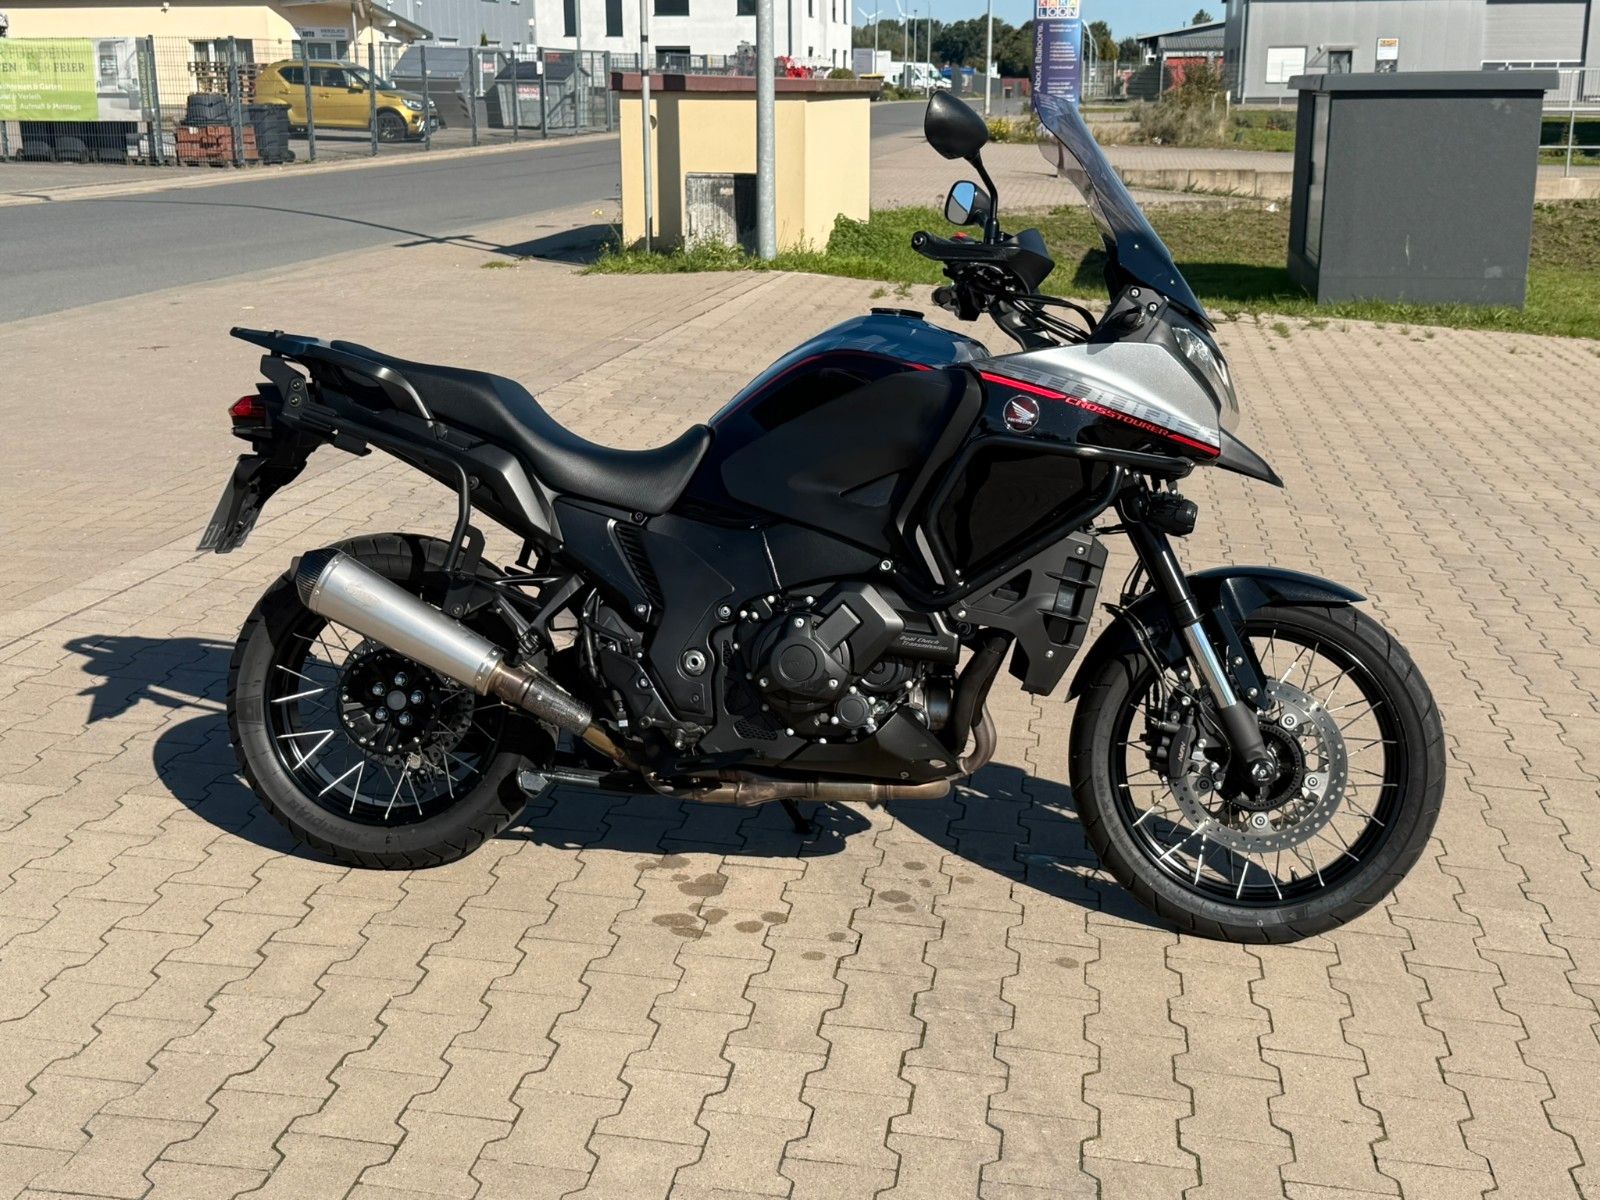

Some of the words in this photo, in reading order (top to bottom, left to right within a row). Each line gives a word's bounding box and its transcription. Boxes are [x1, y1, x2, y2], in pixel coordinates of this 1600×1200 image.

[1039, 7, 1077, 17] LOON
[0, 62, 17, 73] EN
[54, 62, 86, 73] FEIER
[1034, 65, 1042, 92] About
[1065, 396, 1169, 437] CROSSTOURER
[901, 641, 948, 651] Transmission
[916, 637, 940, 645] Clutch
